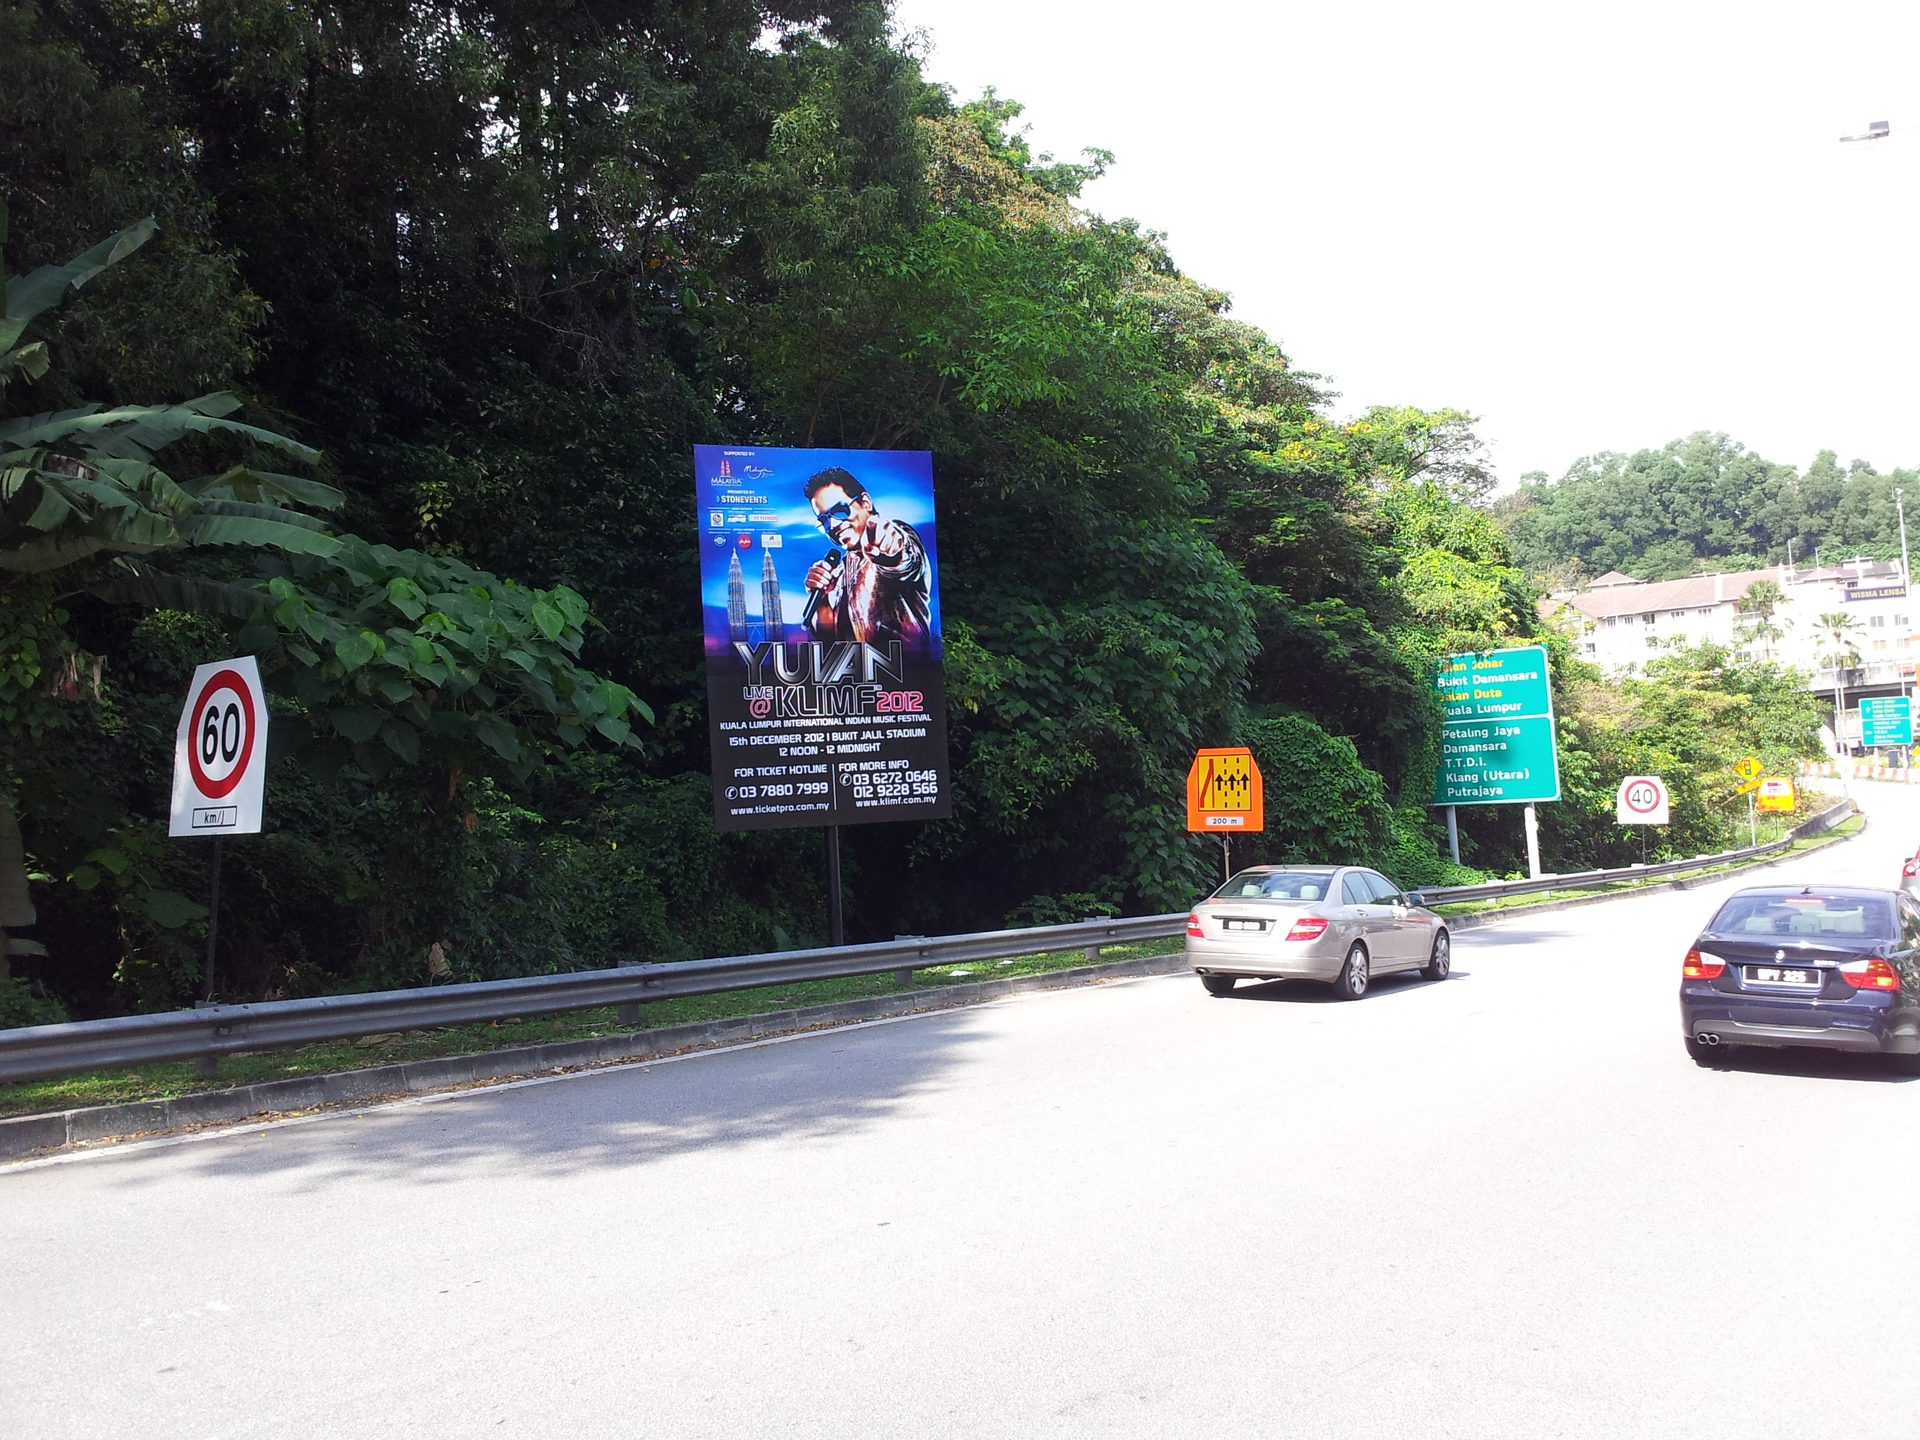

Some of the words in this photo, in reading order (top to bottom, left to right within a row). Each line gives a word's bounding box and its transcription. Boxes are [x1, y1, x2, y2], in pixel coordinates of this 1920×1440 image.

[1879, 588, 1905, 596] LENSA
[732, 640, 903, 686] YUVAN
[1438, 676, 1468, 688] Bukit
[1472, 671, 1538, 685] Damansara
[743, 686, 774, 700] LIVE
[1473, 689, 1502, 700] Duta
[876, 691, 924, 712] 2012
[1477, 702, 1522, 714] Lumpur
[749, 720, 782, 729] LUMPUR
[784, 717, 844, 728] INTERNATIONAL
[845, 716, 871, 725] INDIAN
[872, 715, 896, 724] MUSIC
[898, 714, 932, 722] FESTIVAL
[202, 702, 240, 765] 60
[729, 736, 748, 746] 15th
[750, 734, 802, 745] DECEMBER
[804, 733, 824, 742] 2012
[832, 731, 858, 741] BUKIT
[860, 730, 884, 740] JALIL
[886, 728, 926, 738] STADIUM
[1442, 728, 1489, 739] Petaling
[1494, 726, 1520, 736] Jaya
[779, 748, 788, 756] 12
[790, 746, 818, 756] NOON
[826, 745, 835, 754] 12
[837, 742, 881, 754] MIDNIGHT
[1444, 742, 1507, 754] Damansara
[839, 763, 857, 772] FOR
[860, 761, 886, 771] MORE
[888, 760, 909, 769] INFO
[1445, 757, 1487, 768] T.T.D.I.
[734, 768, 754, 777] FOR
[756, 766, 787, 776] TICKET
[789, 764, 828, 775] HOTLINE
[853, 774, 869, 785] 03
[872, 772, 902, 784] 6272
[906, 770, 937, 782] 0646
[1446, 773, 1478, 783] Klang
[1483, 768, 1530, 781] (Utara)
[740, 786, 757, 798] 03
[760, 784, 793, 797] 7880
[796, 782, 828, 795] 7999
[854, 786, 873, 798] 012
[877, 784, 909, 797] 9228
[912, 782, 938, 794] 566
[1448, 786, 1503, 797] Putrajaya
[1632, 789, 1652, 804] 40
[730, 802, 830, 815] www.ticketpro.com.my
[856, 796, 936, 807] www.klimf.com.my
[204, 812, 225, 824] km/j
